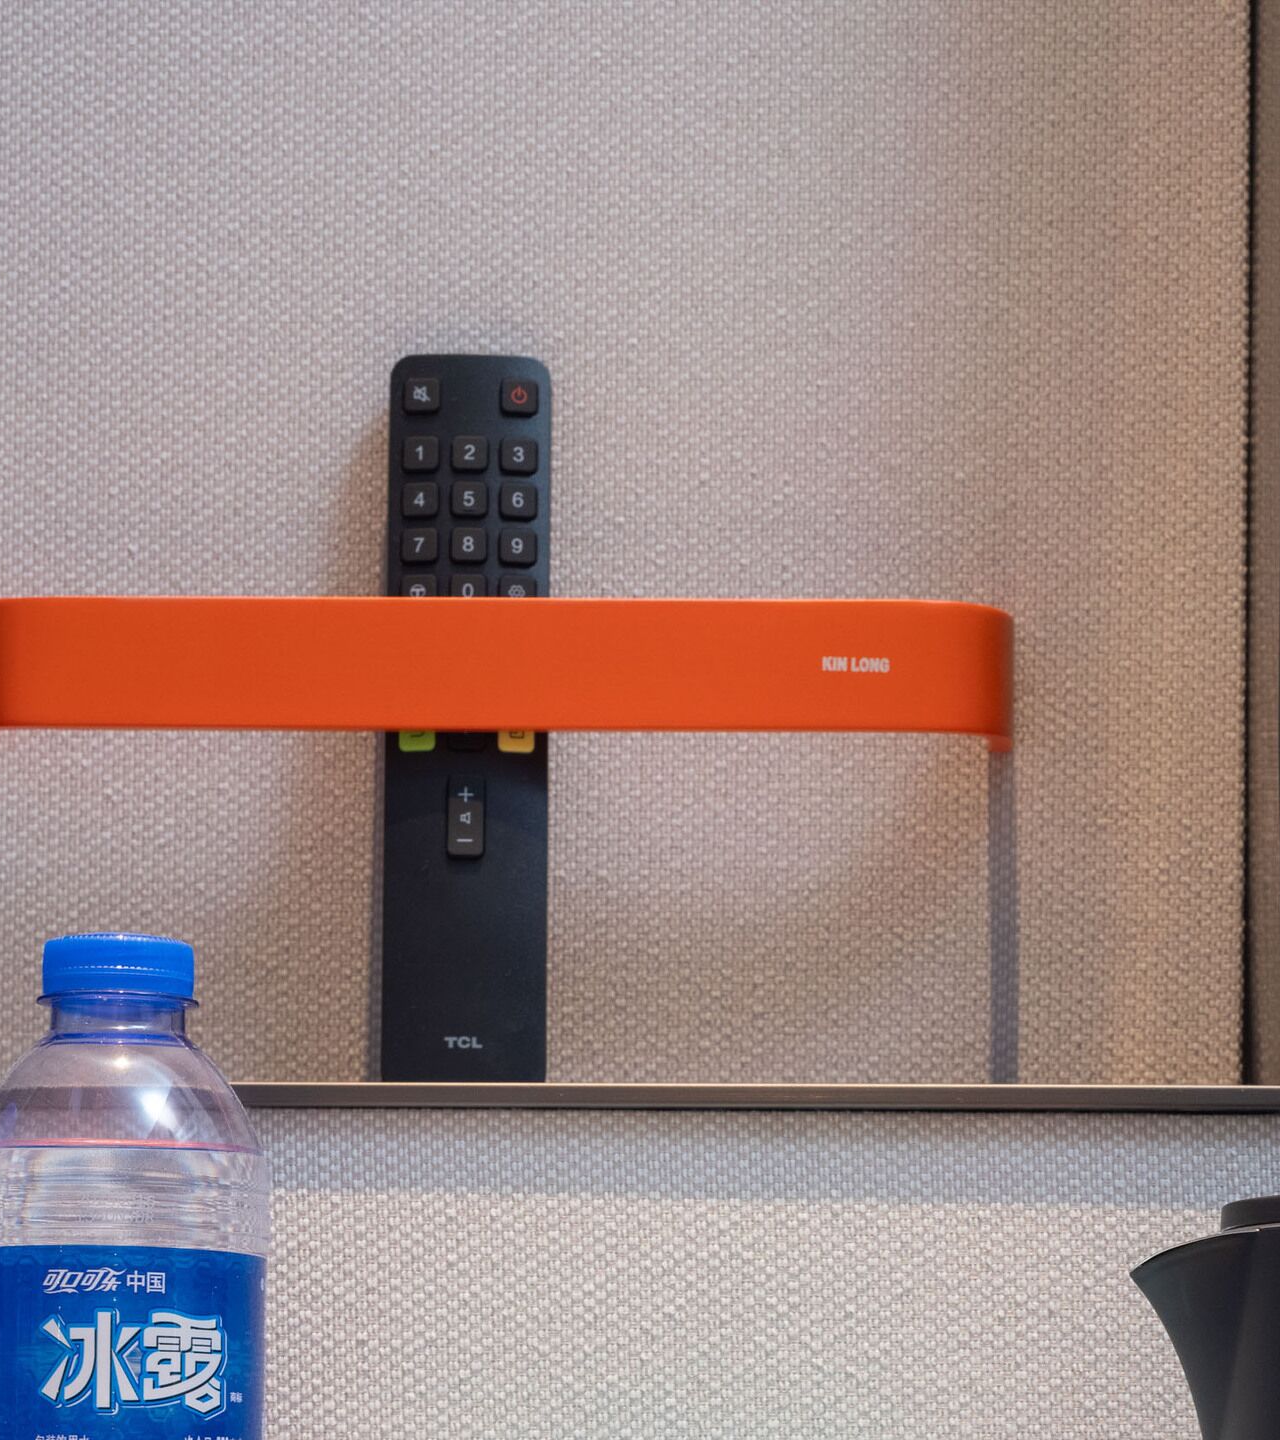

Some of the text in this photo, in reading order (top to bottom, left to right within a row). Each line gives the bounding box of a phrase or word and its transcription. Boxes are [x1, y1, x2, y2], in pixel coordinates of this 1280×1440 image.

[415, 444, 525, 463] 1 2 3
[413, 491, 524, 508] 4 5 6
[413, 536, 523, 554] 7 8 9
[462, 583, 474, 598] 0
[822, 656, 890, 673] KIN LONG
[444, 1036, 483, 1049] TCL
[40, 1309, 226, 1417] 冰露
